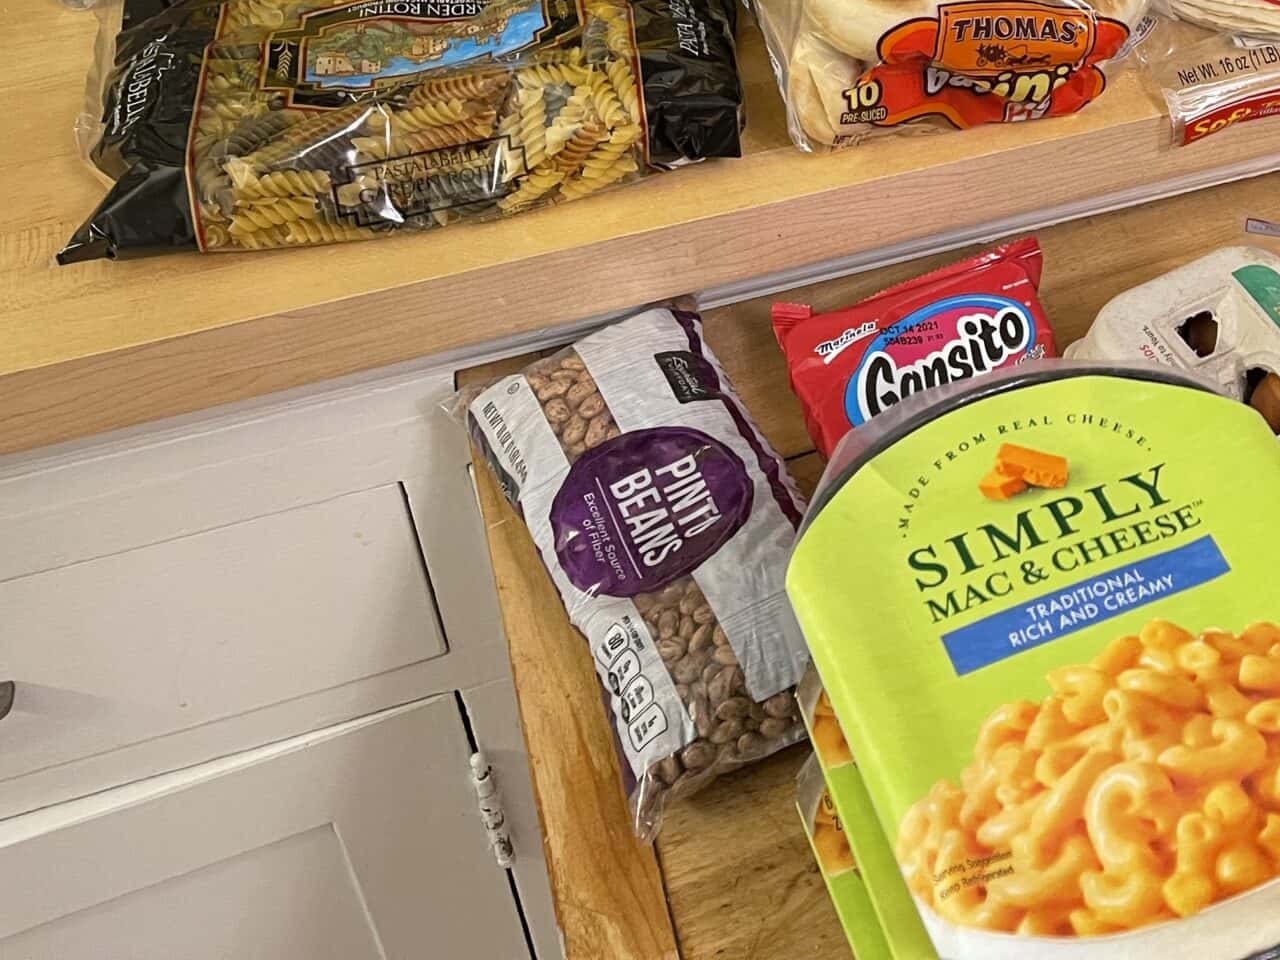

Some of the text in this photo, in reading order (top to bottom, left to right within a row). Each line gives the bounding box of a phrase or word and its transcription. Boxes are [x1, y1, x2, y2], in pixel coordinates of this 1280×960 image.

[360, 3, 423, 17] ROTINI
[1178, 70, 1200, 86] Net
[1200, 63, 1219, 82] Wt.
[1219, 59, 1234, 75] 16
[1235, 55, 1250, 71] oz
[1249, 50, 1262, 72] (1
[842, 108, 886, 123] PRE-SLICED
[846, 83, 879, 109] 10
[374, 162, 423, 180] PASTA
[819, 322, 875, 353] Marinela
[880, 321, 939, 336] OCT 14 2021
[865, 311, 1025, 418] Gansito
[899, 413, 1147, 531] MADE FROM REAL CHEESE
[610, 468, 684, 568] BEANS
[655, 455, 722, 540] PINTO
[582, 518, 606, 563] of Fiber
[583, 492, 627, 581] Excellent Source
[907, 462, 1171, 592] SIMPLY
[923, 504, 1202, 624] MAC & CHEESE
[1008, 574, 1175, 647] RICH AND CREAMY
[1025, 569, 1145, 622] TRADITIONAL
[608, 632, 624, 650] 80
